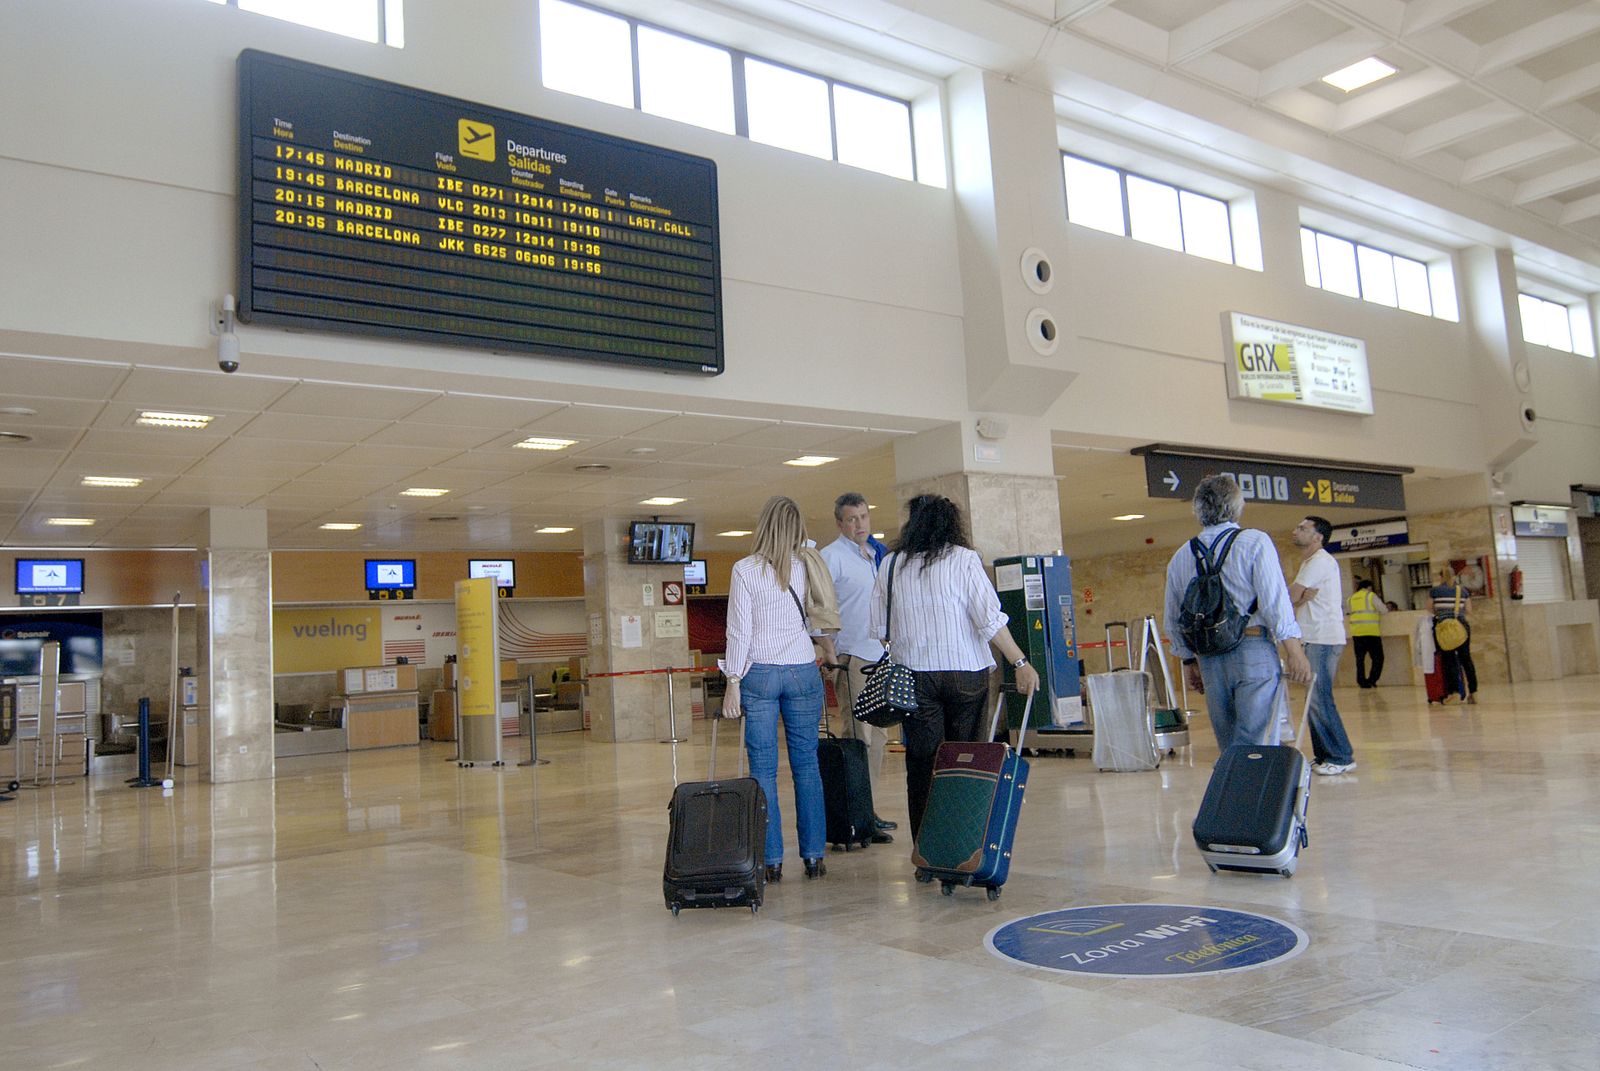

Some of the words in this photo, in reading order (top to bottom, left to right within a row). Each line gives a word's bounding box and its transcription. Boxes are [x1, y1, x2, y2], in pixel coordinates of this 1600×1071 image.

[273, 118, 293, 129] Time
[273, 127, 293, 139] Hora
[333, 130, 371, 146] Destination
[334, 140, 363, 153] Destino
[507, 140, 567, 164] Departures
[435, 152, 453, 163] Flight
[508, 154, 552, 175] Salidas
[436, 161, 457, 172] Vuelo
[511, 168, 534, 179] Counter
[511, 176, 544, 190] Mostrador
[276, 145, 325, 166] 17:45
[336, 157, 392, 179] MADRID
[438, 177, 463, 193] IBE
[472, 184, 503, 200] 0271
[562, 202, 599, 219] 17:06
[608, 211, 613, 221] 1
[629, 215, 691, 237] LAST.CALL
[276, 167, 325, 187] 19:45
[336, 178, 420, 205] BARCELONA
[473, 204, 506, 220] 2013
[563, 220, 600, 238] 19:10
[275, 188, 325, 208] 20:15
[336, 200, 392, 220] MADRID
[438, 218, 464, 232] IBE
[473, 224, 506, 239] 0277
[563, 239, 600, 256] 19:36
[275, 210, 326, 229] 20:35
[336, 220, 420, 245] BARCELONA
[439, 238, 464, 252] JKK
[473, 243, 507, 258] 6625
[564, 258, 601, 274] 19:56
[1240, 343, 1280, 371] GRX
[396, 590, 404, 600] 9
[691, 586, 700, 594] 12
[57, 595, 66, 606] 7
[293, 617, 367, 641] vueling
[1060, 939, 1144, 965] Zona
[1136, 915, 1218, 939] Wi-Fi
